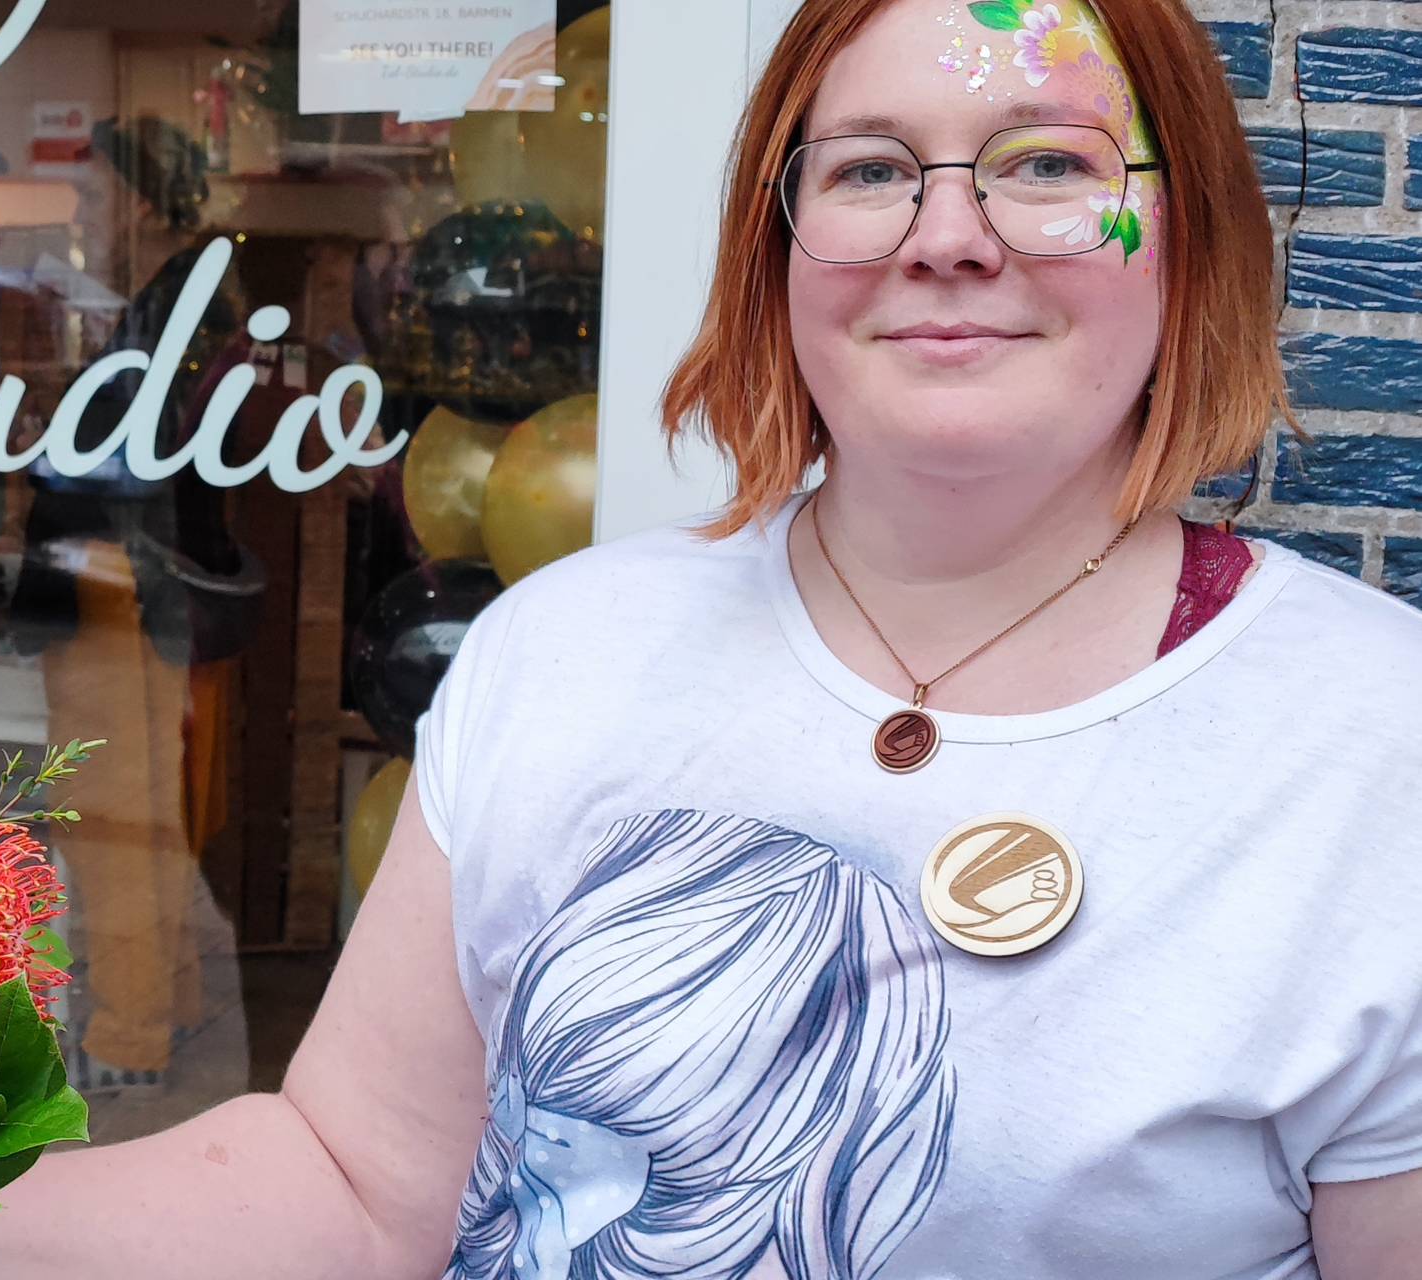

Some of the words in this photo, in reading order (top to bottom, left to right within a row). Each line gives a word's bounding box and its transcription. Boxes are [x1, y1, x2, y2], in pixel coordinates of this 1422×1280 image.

[349, 43, 379, 60] SEE
[384, 42, 423, 58] YOU
[427, 41, 494, 58] THERE!
